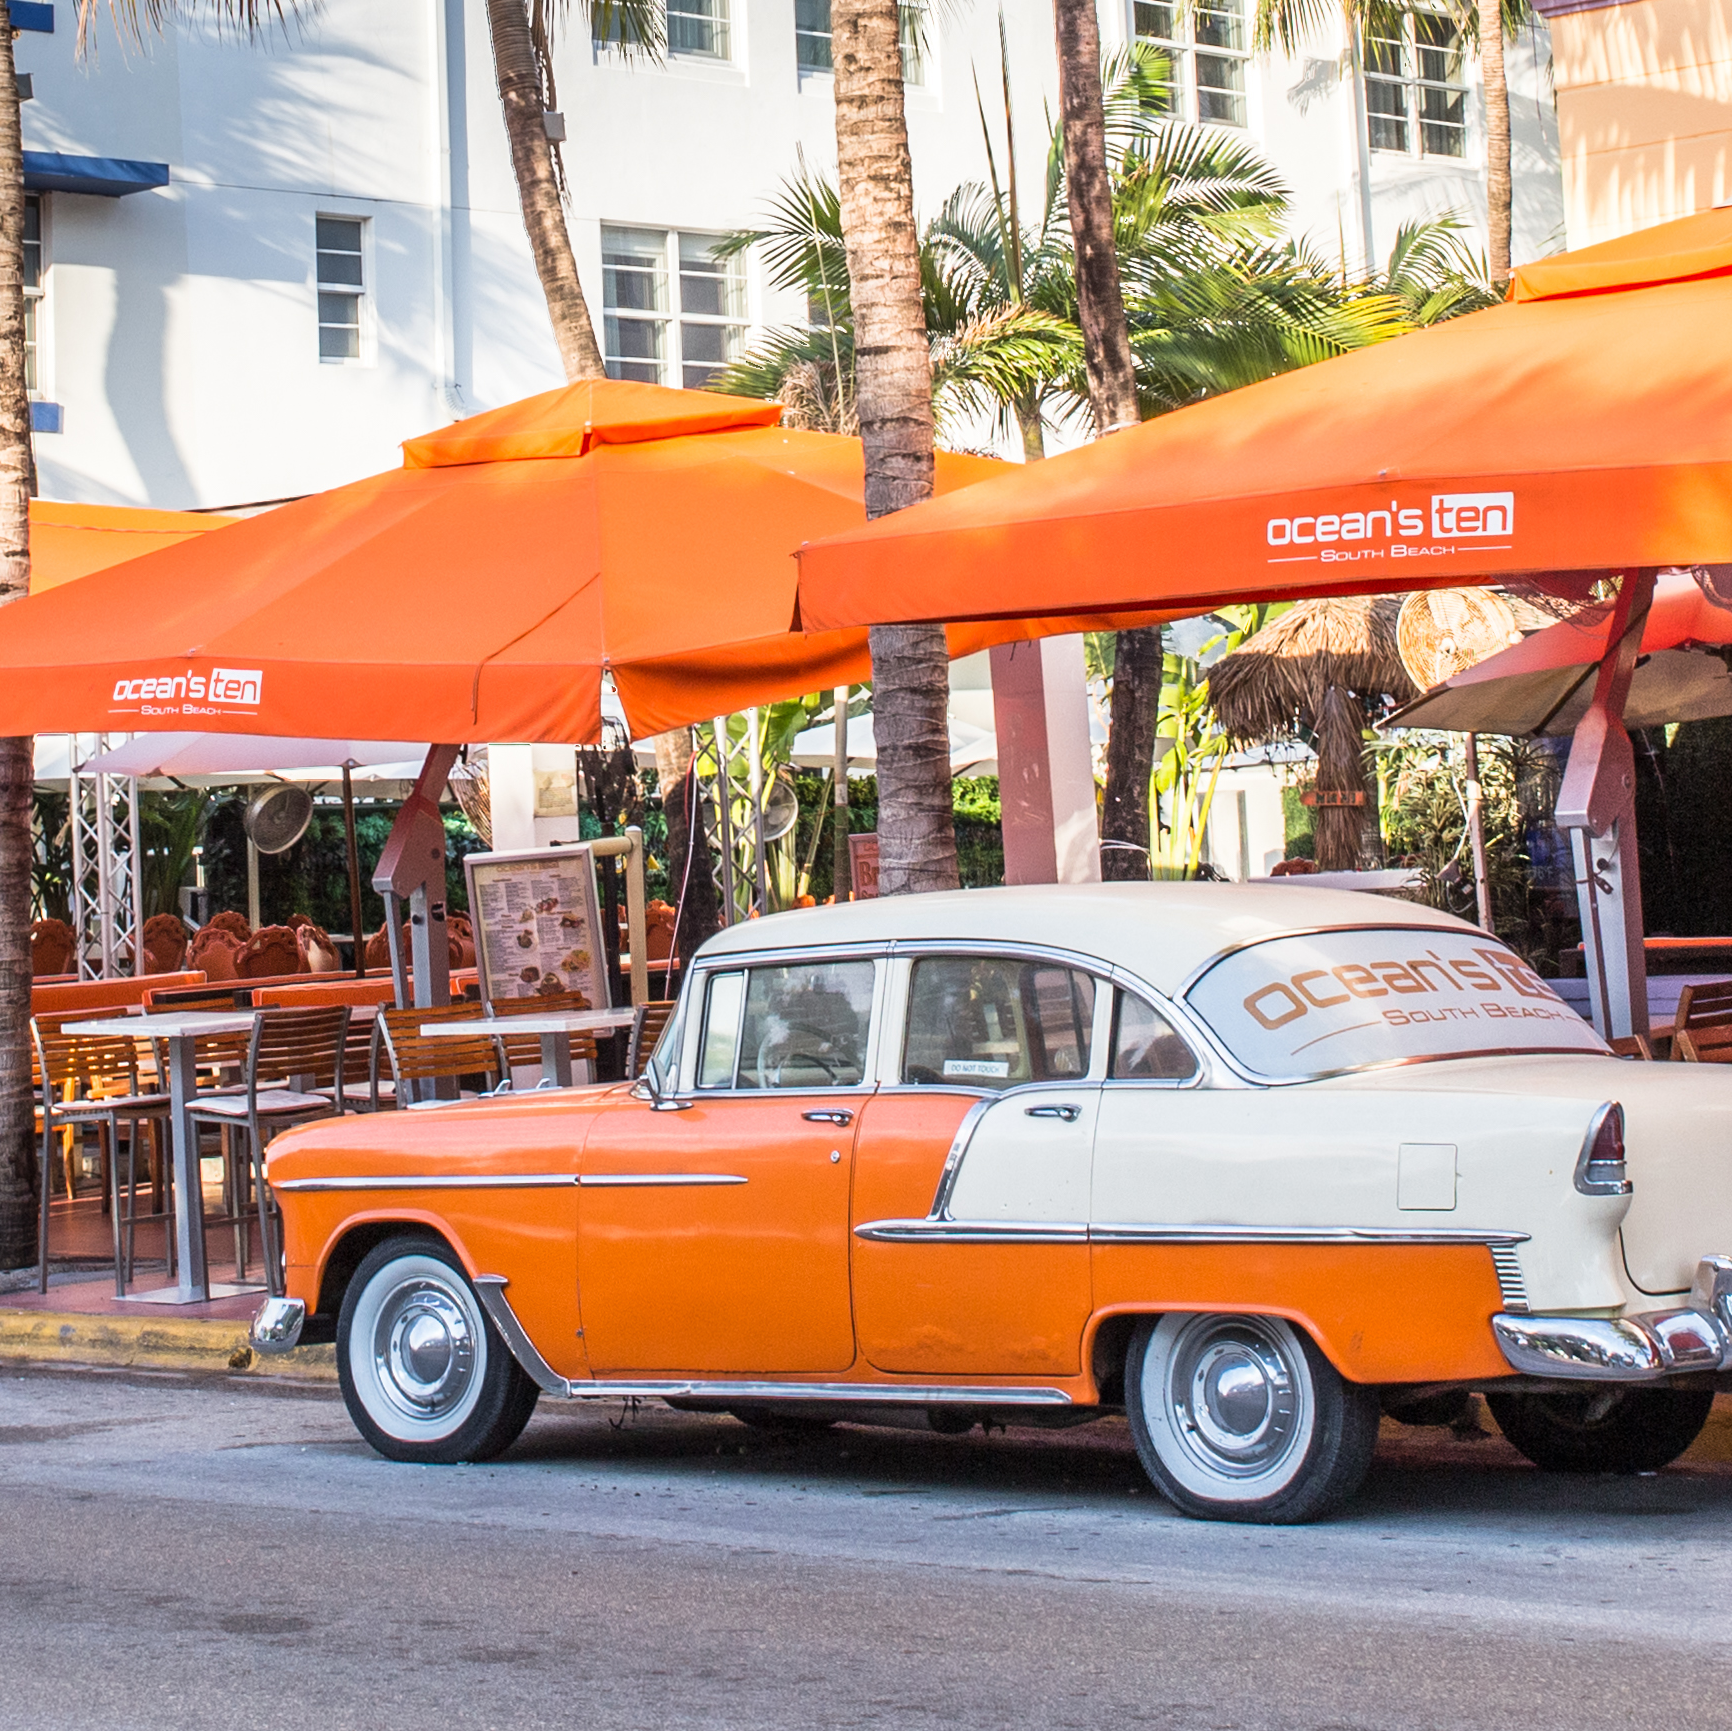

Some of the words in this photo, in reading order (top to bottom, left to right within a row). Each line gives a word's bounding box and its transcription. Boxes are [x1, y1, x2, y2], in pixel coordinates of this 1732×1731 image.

[1267, 500, 1424, 546] ocean's
[1433, 495, 1511, 536] ten
[113, 669, 207, 701] ocean's
[210, 669, 260, 702] ten
[1243, 949, 1502, 1030] ocean's
[1475, 949, 1567, 1004] te
